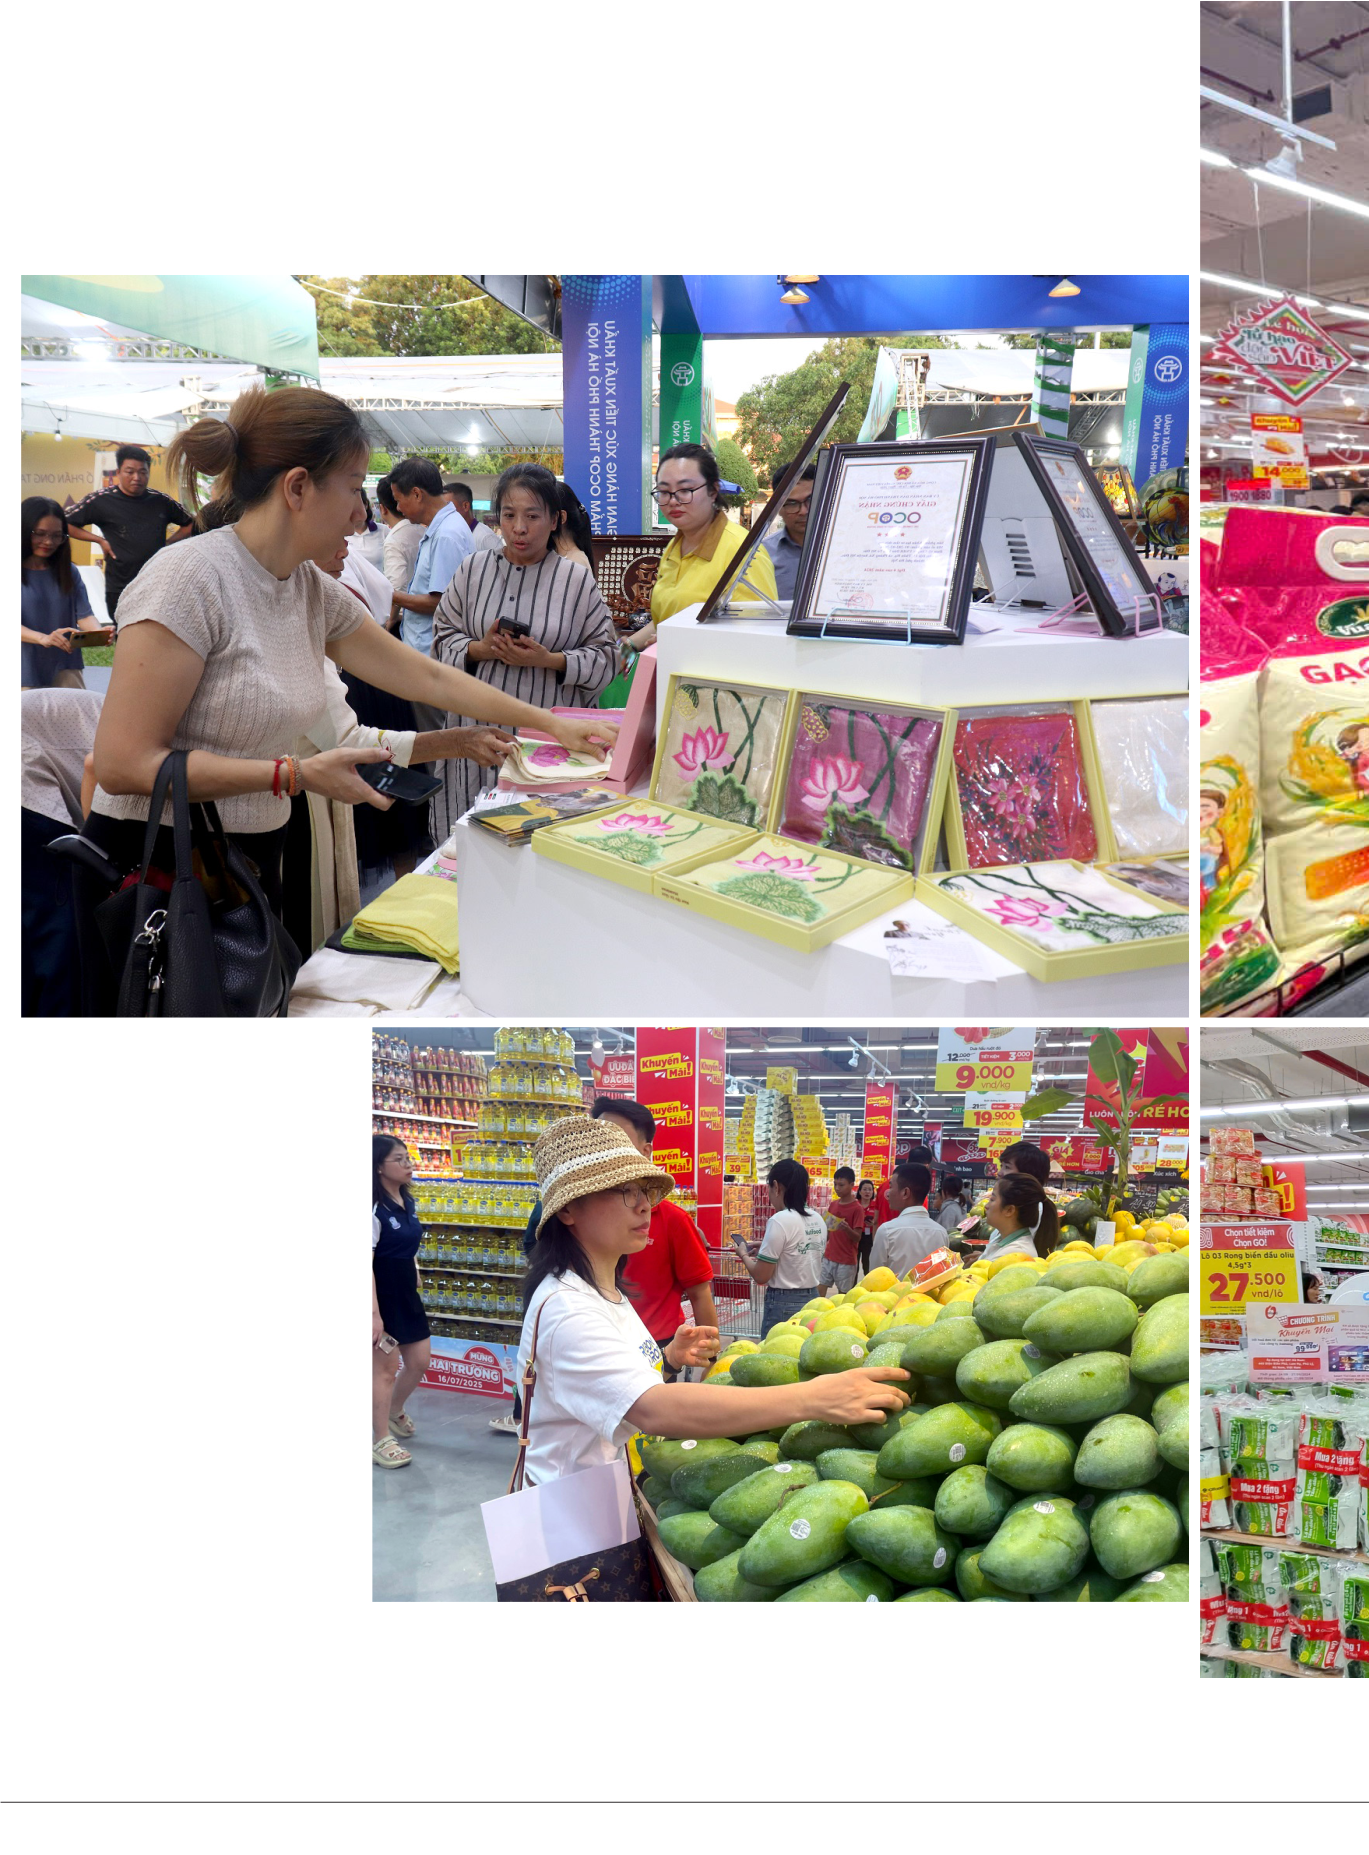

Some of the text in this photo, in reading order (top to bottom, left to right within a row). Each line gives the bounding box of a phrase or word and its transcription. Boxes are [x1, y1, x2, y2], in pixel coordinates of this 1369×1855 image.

[642, 1055, 680, 1069] Khuyến
[956, 1065, 1015, 1089] 9.000
[981, 1081, 1011, 1089] vnd/kg
[974, 1111, 1015, 1126] 19.900
[1224, 1229, 1243, 1238] Chọn
[1257, 1228, 1275, 1238] kiệm
[1233, 1239, 1252, 1248] Chọn
[1208, 1273, 1285, 1301] 27.500
[1251, 1289, 1283, 1298] vnd/lô
[438, 1375, 482, 1388] 16/07/2025
[1314, 1451, 1330, 1461] Mua
[1337, 1453, 1354, 1466] tặng
[1240, 1482, 1255, 1492] Mua
[1263, 1484, 1280, 1494] tặng
